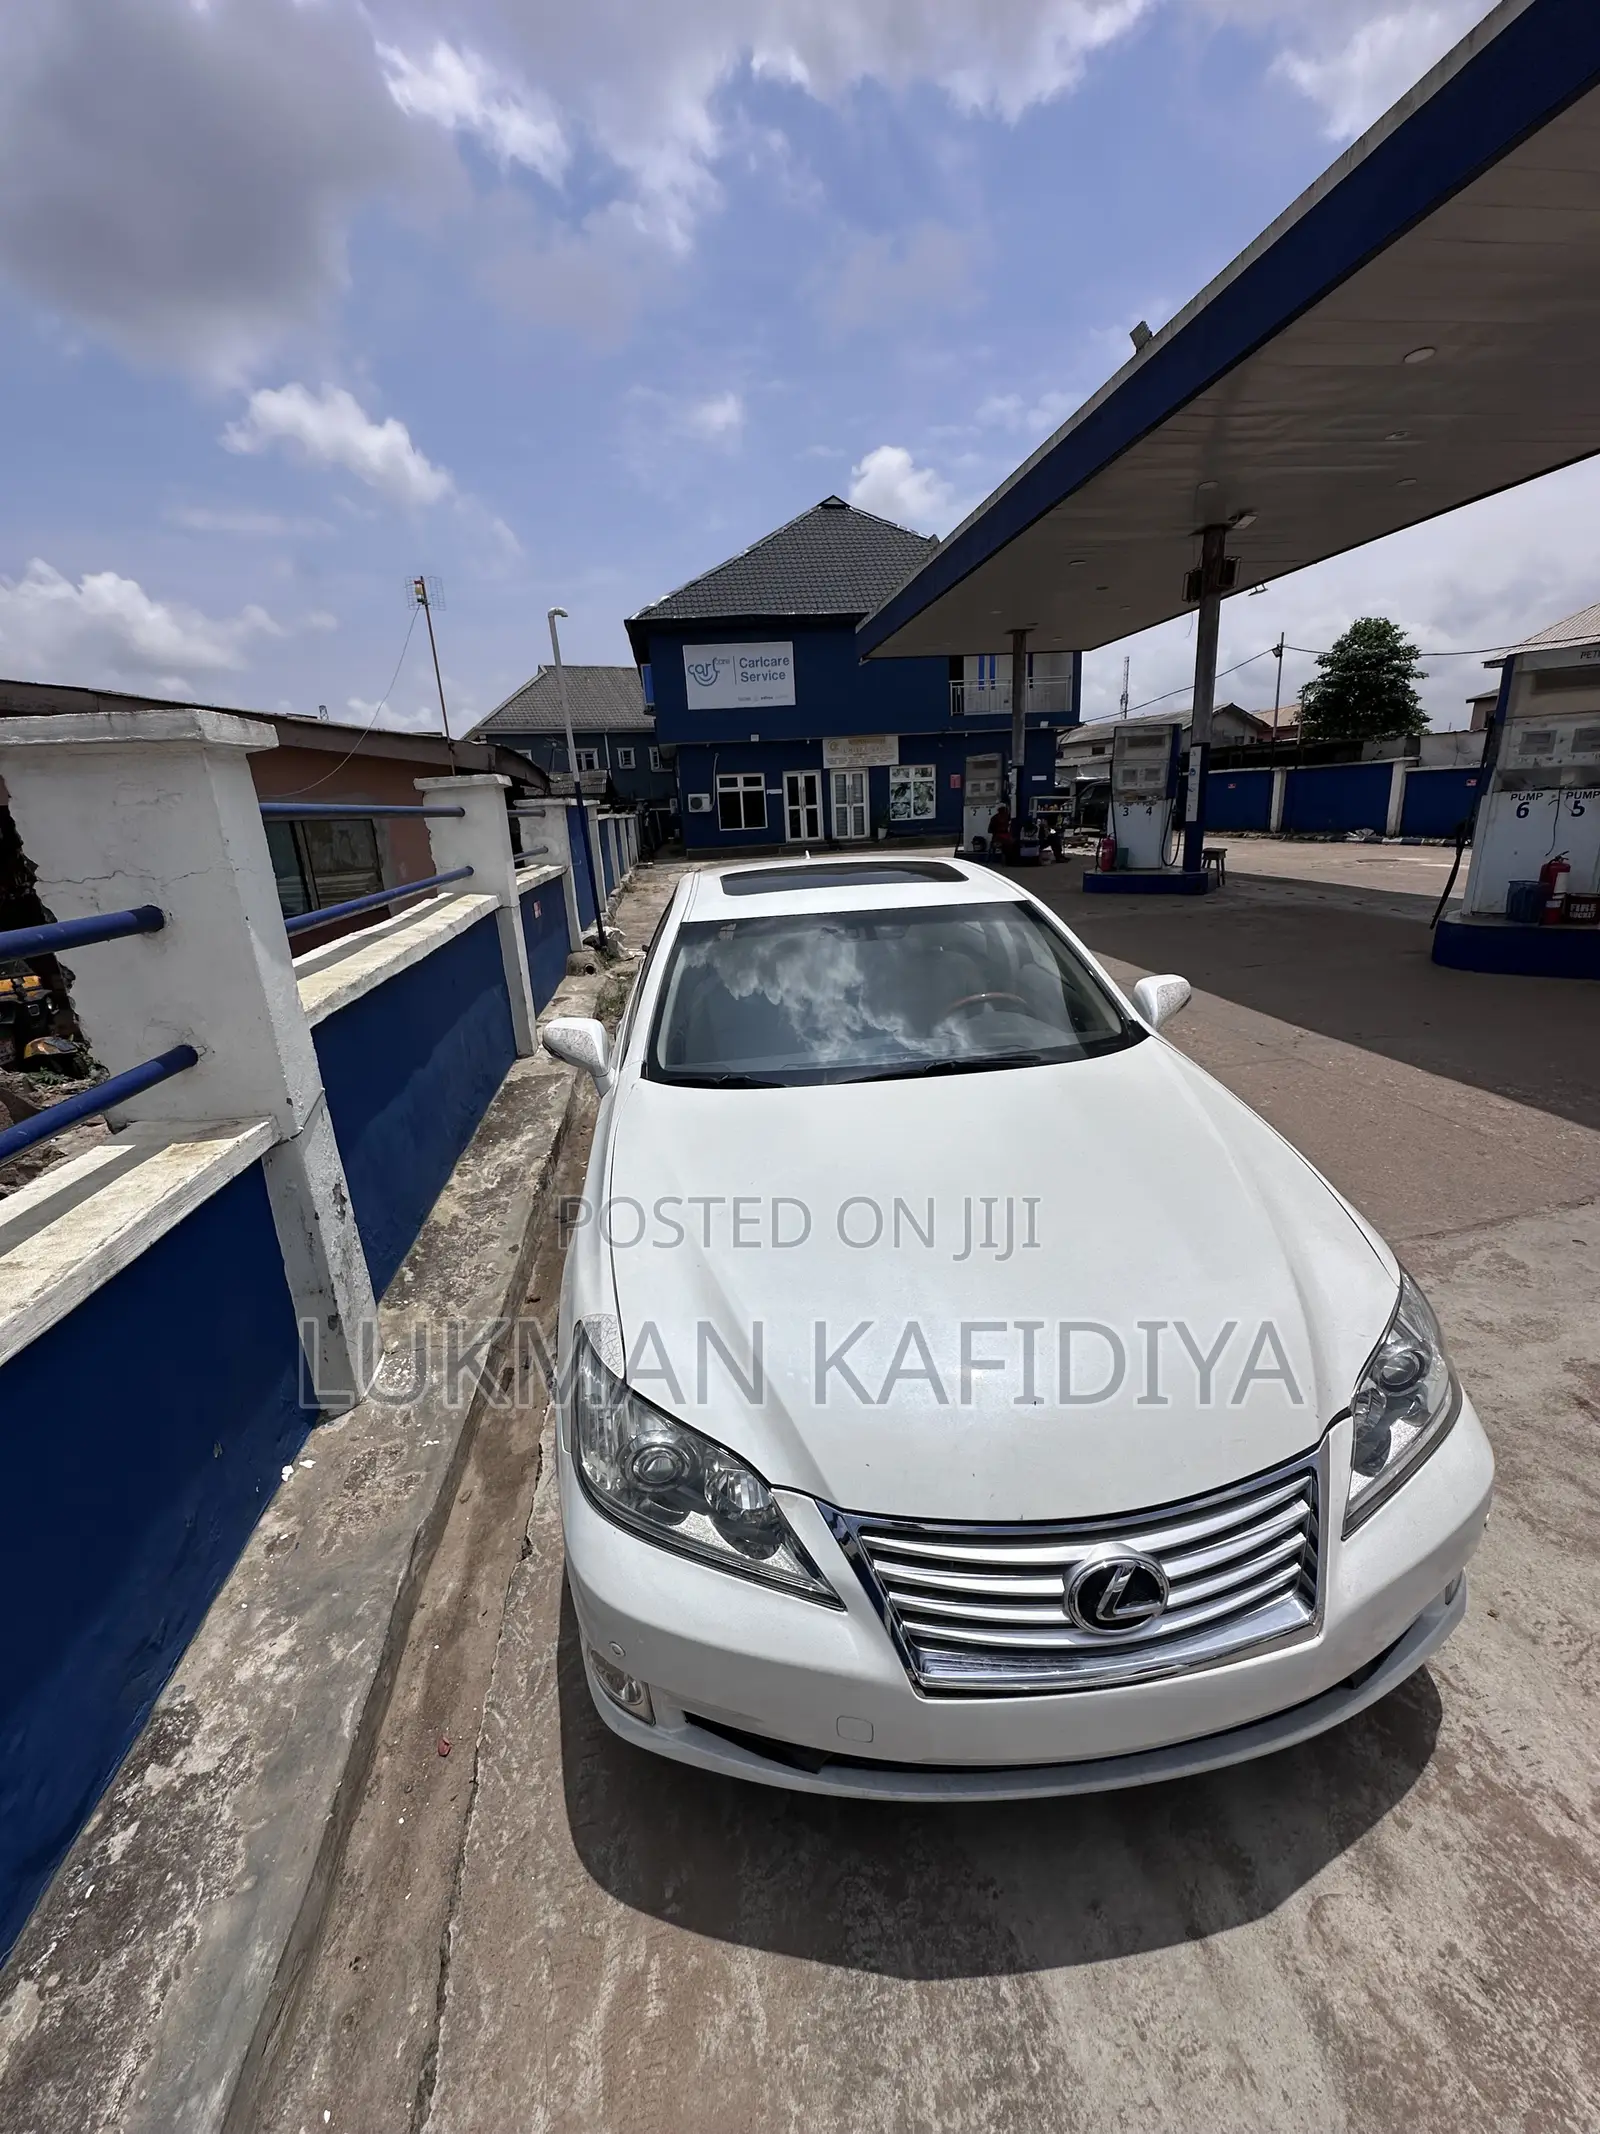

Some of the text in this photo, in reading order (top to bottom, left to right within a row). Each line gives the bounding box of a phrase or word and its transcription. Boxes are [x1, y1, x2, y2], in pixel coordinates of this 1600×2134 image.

[739, 656, 790, 669] Carlcare
[740, 670, 786, 683] Service
[1511, 792, 1543, 801] PUMP
[1566, 790, 1600, 799] PUMP
[972, 808, 977, 816] 2
[1123, 807, 1129, 816] 3
[1146, 806, 1152, 816] 4
[1516, 802, 1529, 818] 6
[1571, 800, 1585, 817] 5
[1570, 904, 1597, 912] FIRE
